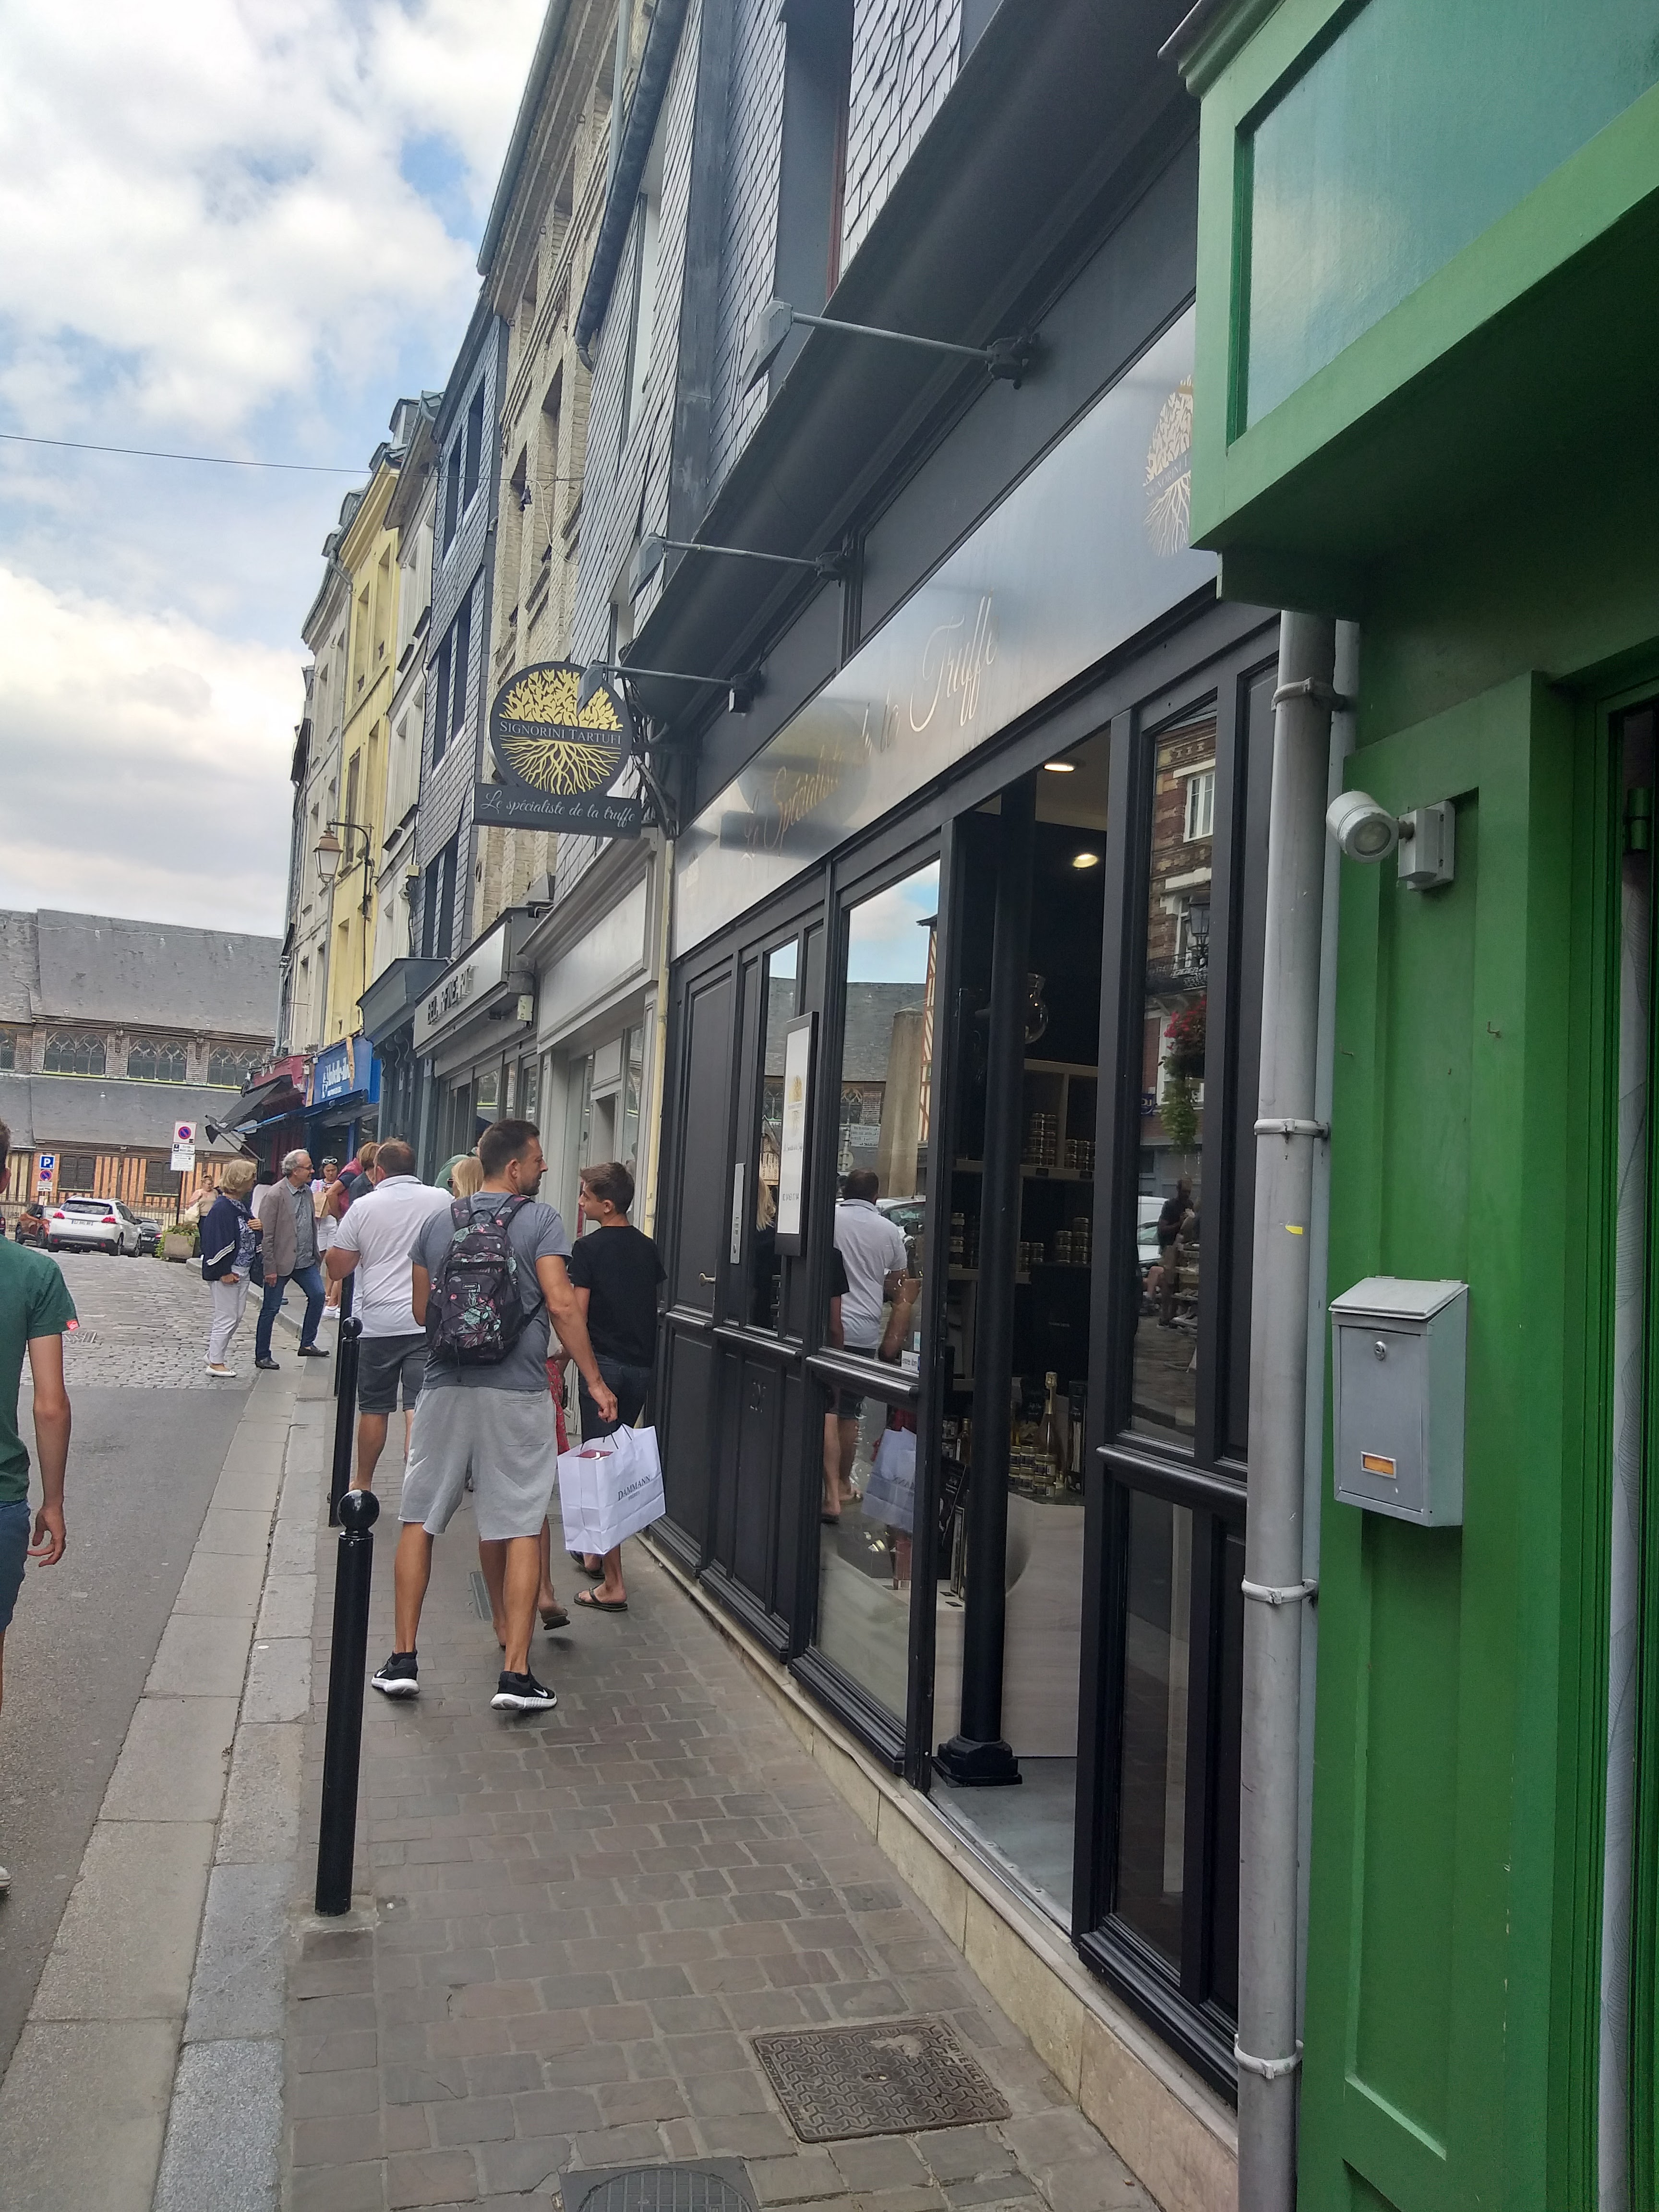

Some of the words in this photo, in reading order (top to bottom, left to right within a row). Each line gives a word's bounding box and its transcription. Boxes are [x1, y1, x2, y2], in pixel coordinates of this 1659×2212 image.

[909, 587, 998, 732] Truffe
[499, 721, 565, 739] SIGNORINI
[569, 729, 622, 745] TARTUFI
[481, 790, 502, 814] Le
[506, 798, 565, 816] spécialiste
[569, 802, 584, 817] de
[587, 805, 600, 818] la
[604, 806, 635, 829] truffe
[618, 1474, 650, 1501] DAMMANN
[944, 2038, 969, 2064] FONTE
[964, 2064, 995, 2099] DUCTILE
